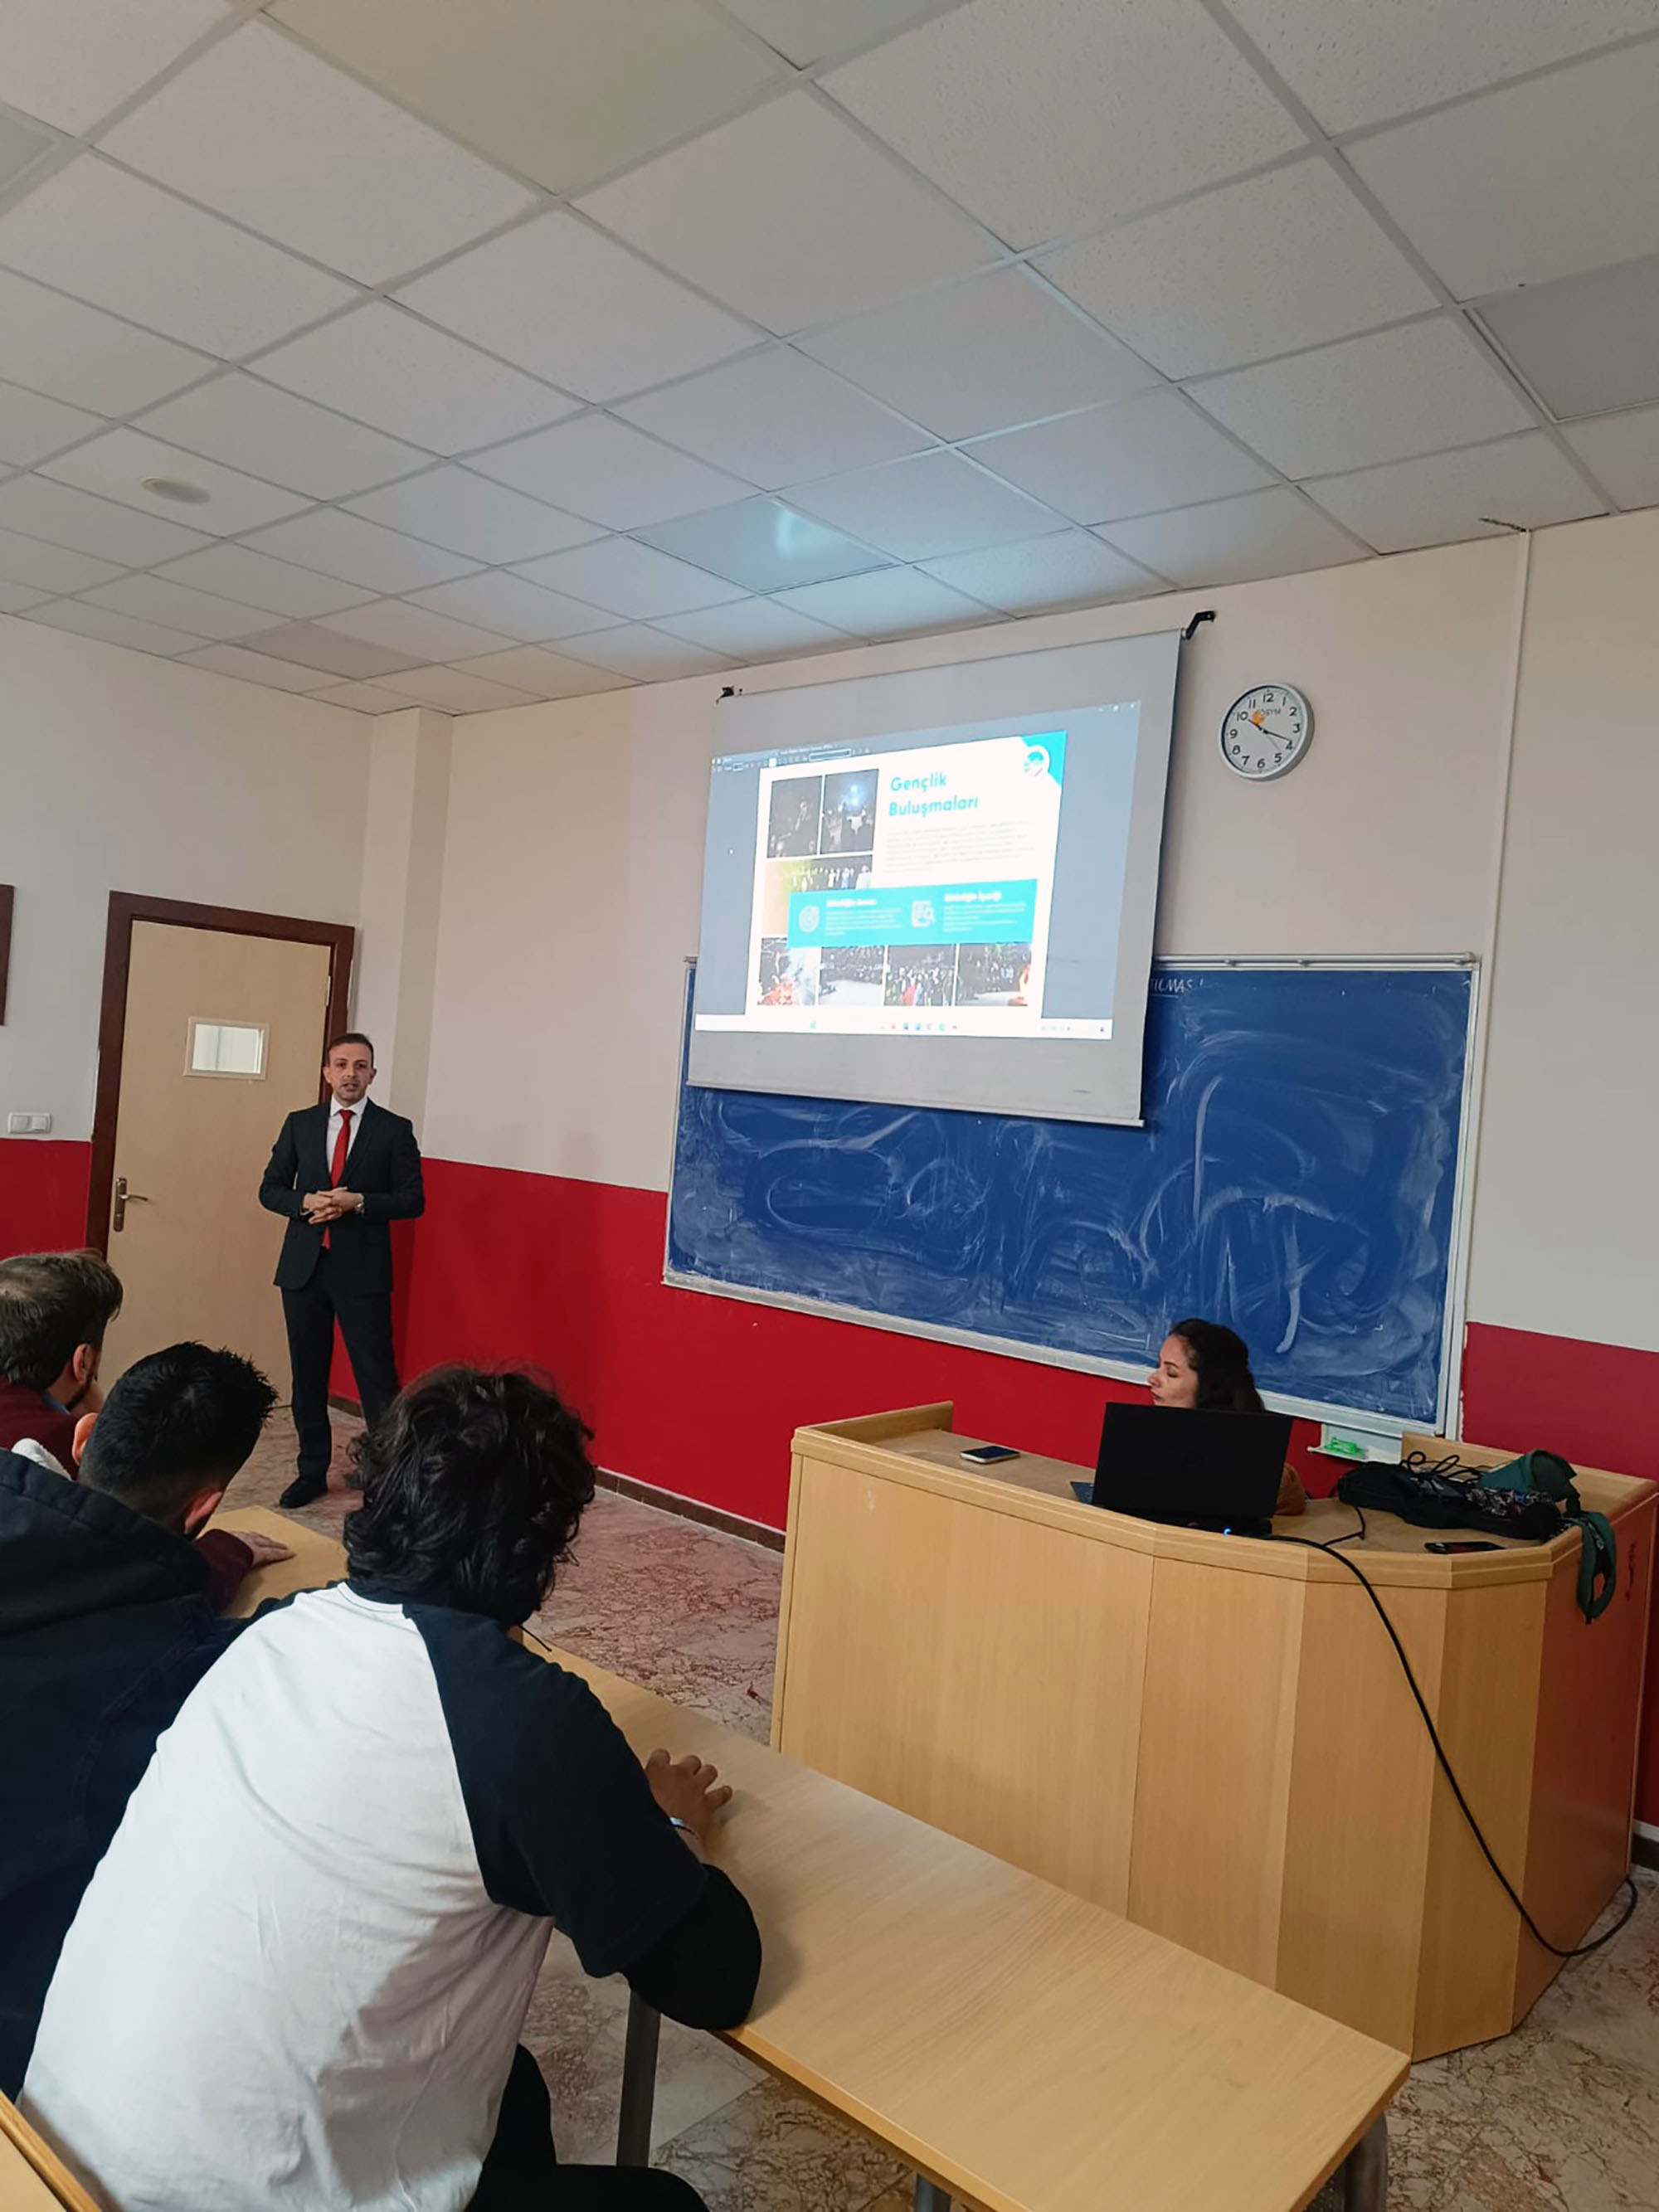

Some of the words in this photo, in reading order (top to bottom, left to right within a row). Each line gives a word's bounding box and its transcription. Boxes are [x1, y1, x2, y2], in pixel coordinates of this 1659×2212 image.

[1262, 693, 1275, 703] 12
[1282, 697, 1287, 707] 1
[1248, 699, 1256, 708] 11
[1237, 712, 1248, 722] 10
[1289, 707, 1297, 717] 2
[1292, 723, 1301, 733] 3
[1229, 729, 1238, 739] 9
[1232, 745, 1240, 755] 8
[1286, 740, 1293, 751] 4
[1241, 755, 1249, 766] 7
[1274, 752, 1282, 763] 5
[1257, 758, 1265, 768] 6
[890, 771, 947, 792] Gençlik
[888, 795, 979, 818] Buluşmaları
